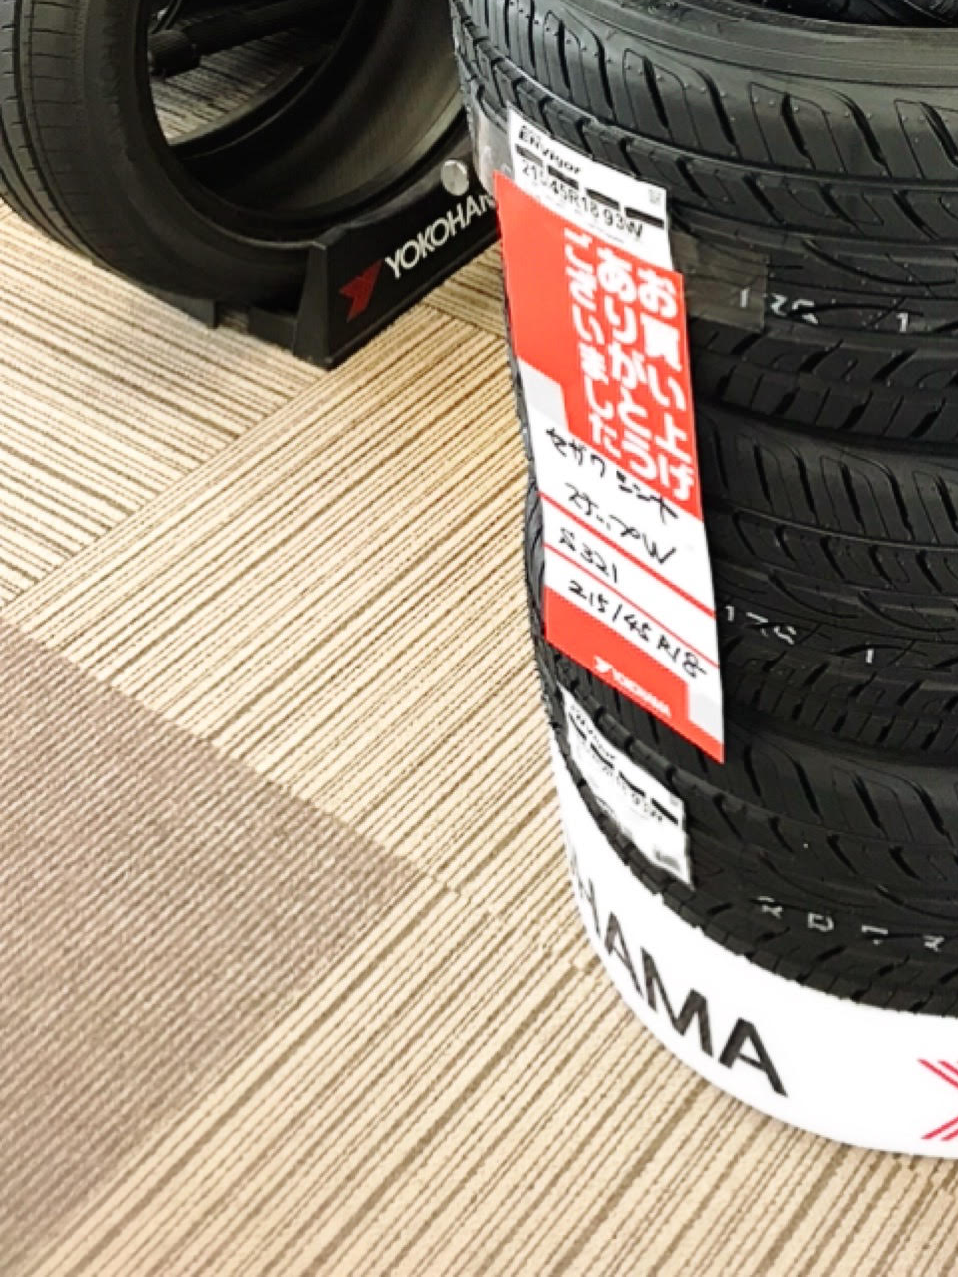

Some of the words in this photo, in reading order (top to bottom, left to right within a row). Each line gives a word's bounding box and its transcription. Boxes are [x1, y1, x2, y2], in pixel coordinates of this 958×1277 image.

[384, 193, 498, 280] YOKOHAM
[563, 226, 623, 460] ございました
[596, 245, 658, 481] ありがとう
[637, 268, 697, 501] お買い上げ
